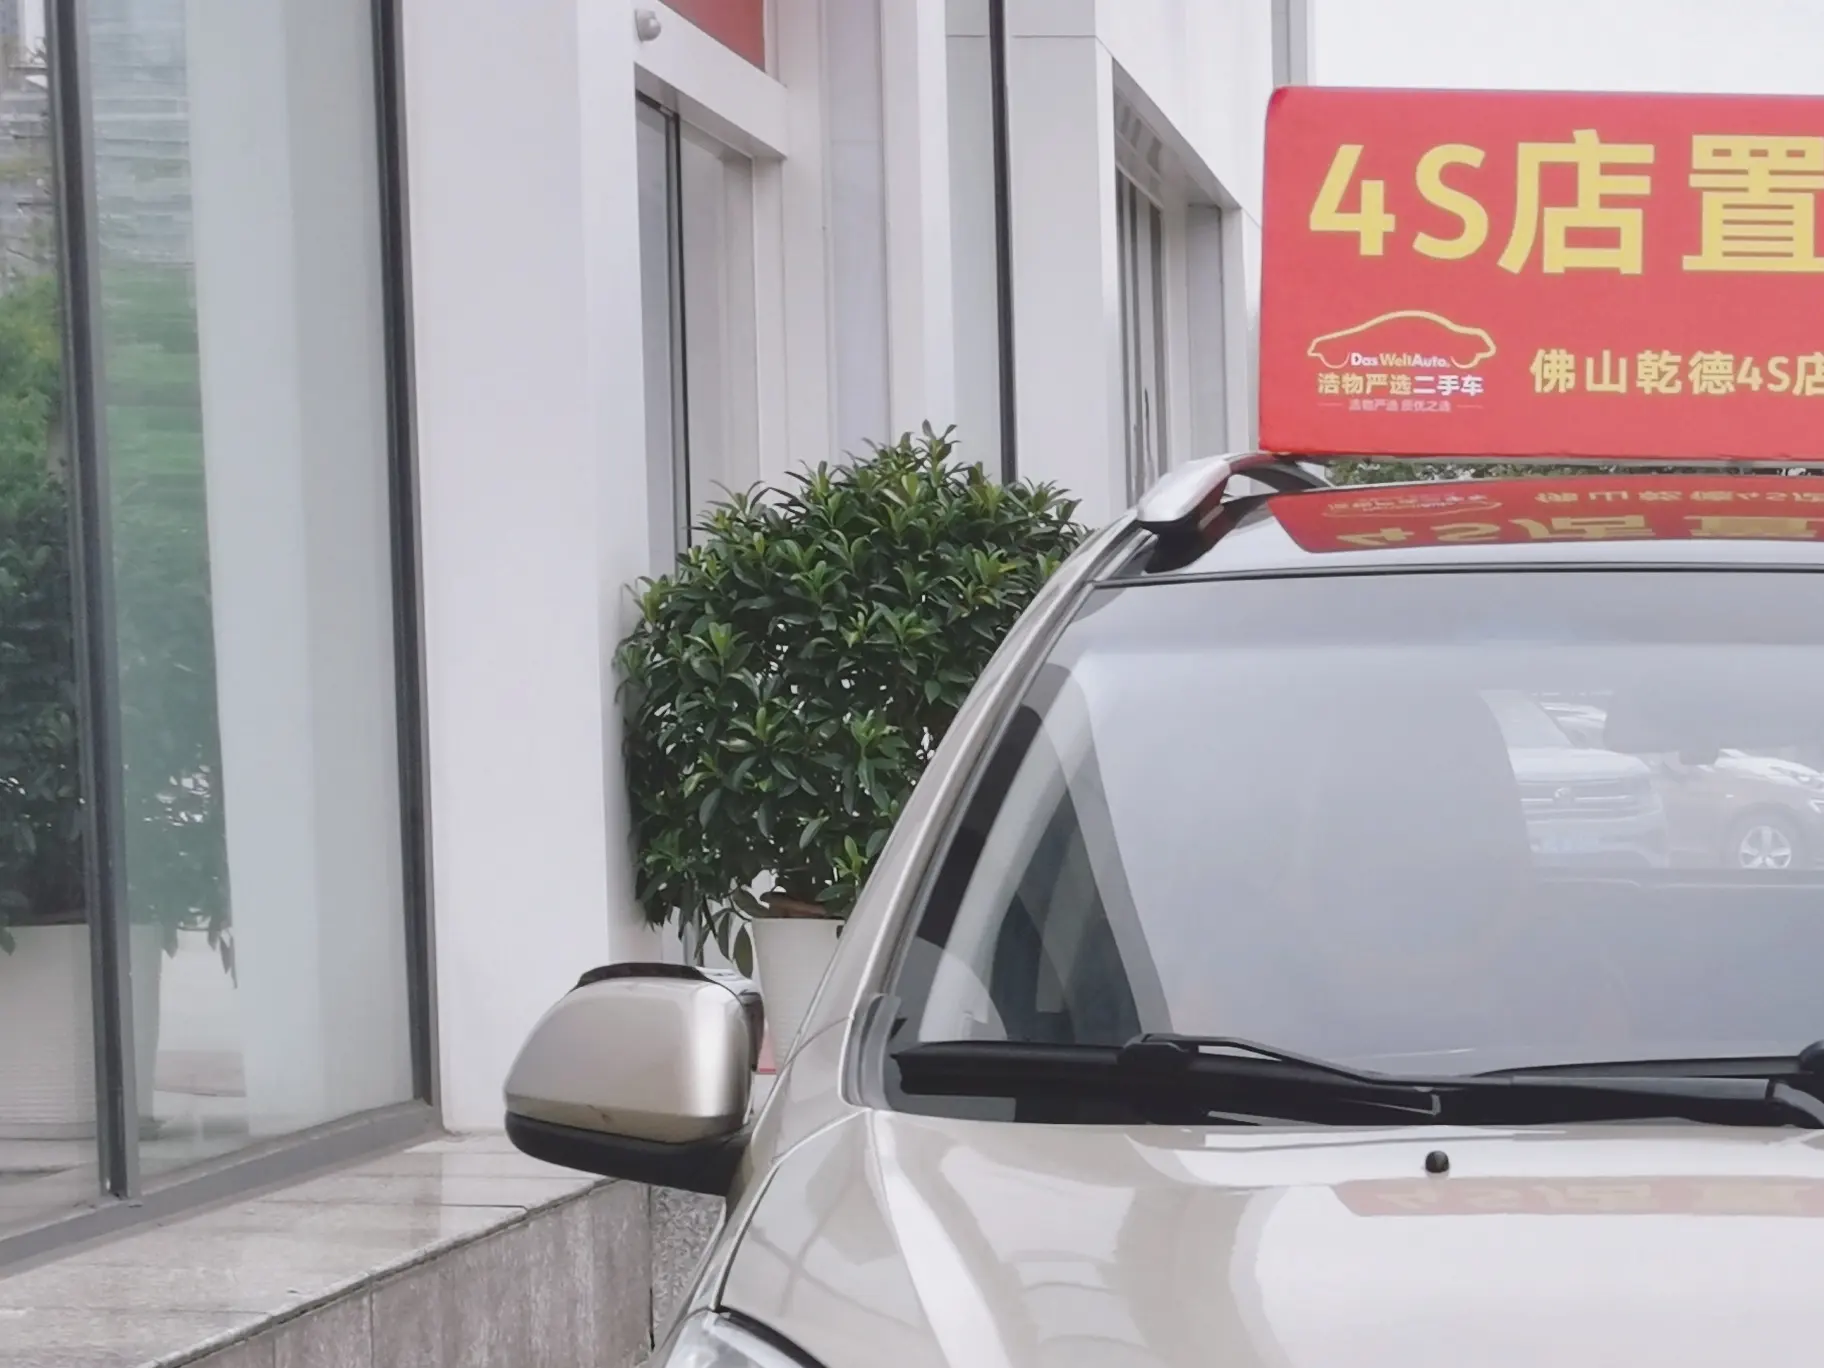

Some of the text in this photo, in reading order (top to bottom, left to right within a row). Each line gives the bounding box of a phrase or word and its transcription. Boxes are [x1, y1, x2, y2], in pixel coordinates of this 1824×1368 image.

[1351, 352, 1378, 366] Das
[1317, 372, 1485, 396] 浩物严选二手车
